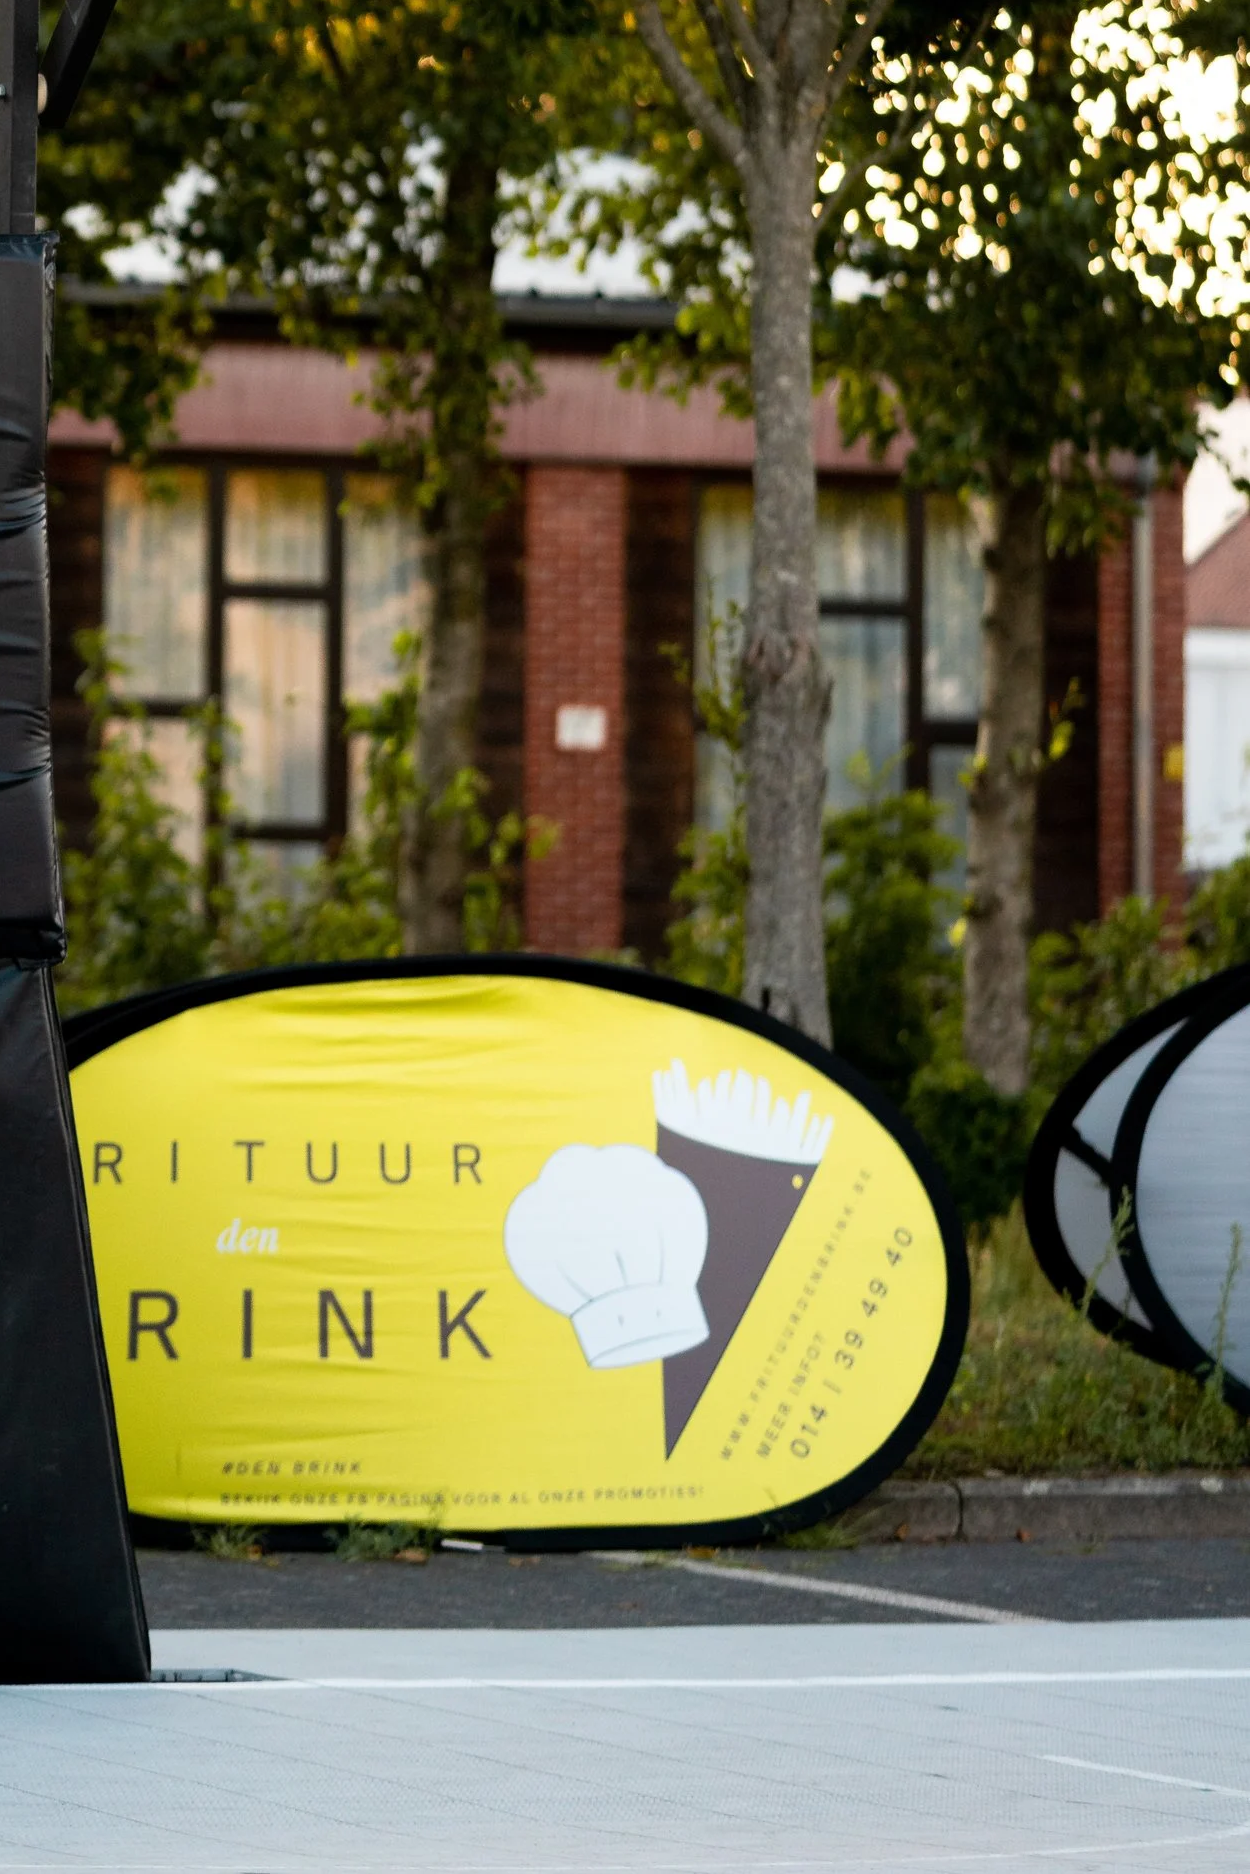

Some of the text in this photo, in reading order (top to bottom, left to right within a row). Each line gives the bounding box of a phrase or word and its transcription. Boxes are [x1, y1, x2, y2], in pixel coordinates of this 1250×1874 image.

[216, 1218, 279, 1254] den
[790, 1403, 828, 1459] 014
[834, 1329, 864, 1370] 39
[861, 1277, 889, 1319] 49
[886, 1226, 913, 1268] 40
[756, 1330, 826, 1459] MEER INFO?
[222, 1461, 361, 1475] #DEN BRINK
[290, 1492, 339, 1505] ONZE
[347, 1492, 368, 1505] FB
[377, 1493, 445, 1506] PAGINA
[452, 1492, 502, 1506] VOOR
[510, 1490, 529, 1504] AL
[538, 1489, 585, 1504] ONZE
[593, 1485, 705, 1502] PROMOTIES!
